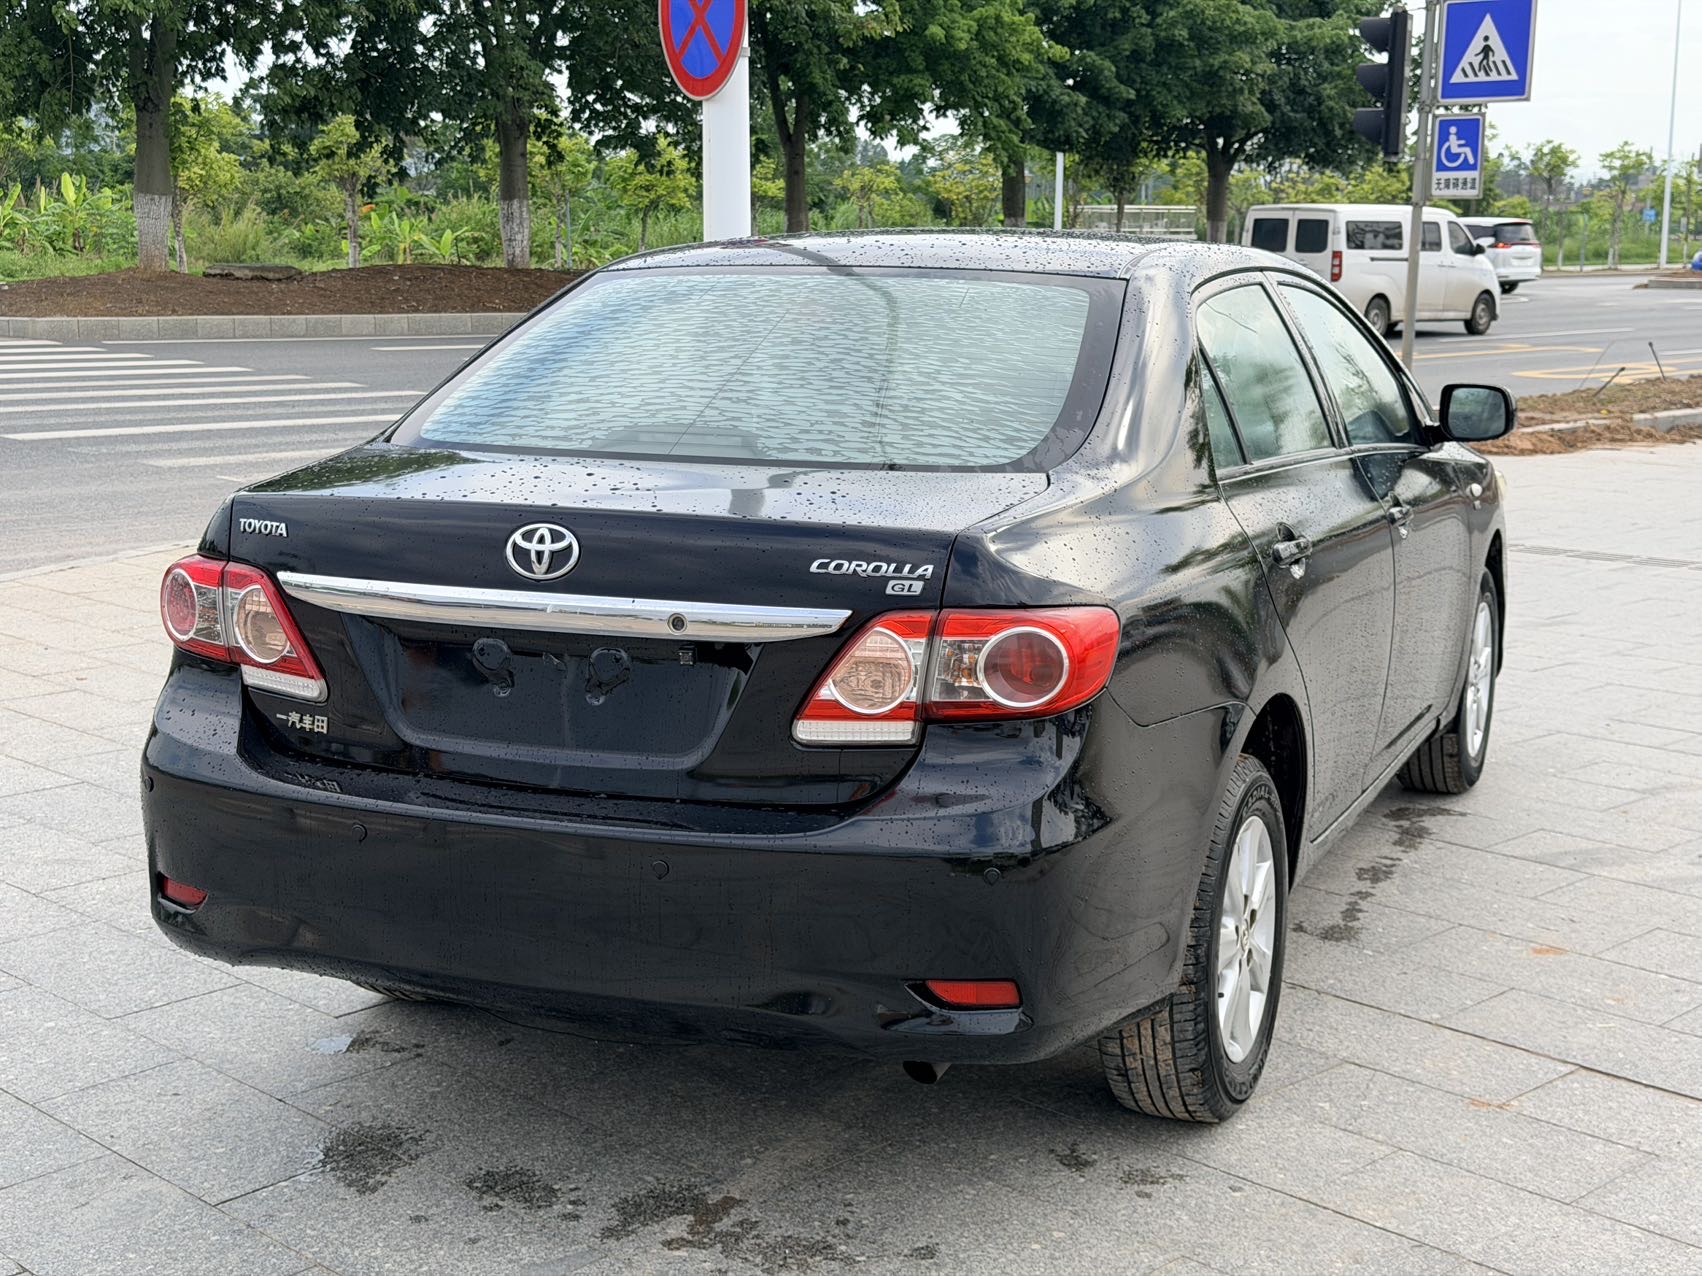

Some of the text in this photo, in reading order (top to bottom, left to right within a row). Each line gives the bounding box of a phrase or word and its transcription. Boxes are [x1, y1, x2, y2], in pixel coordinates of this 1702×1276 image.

[239, 518, 288, 537] TOYOTA
[809, 559, 934, 579] COROLLA
[891, 583, 918, 593] GL
[276, 711, 328, 734] 一汽丰田
